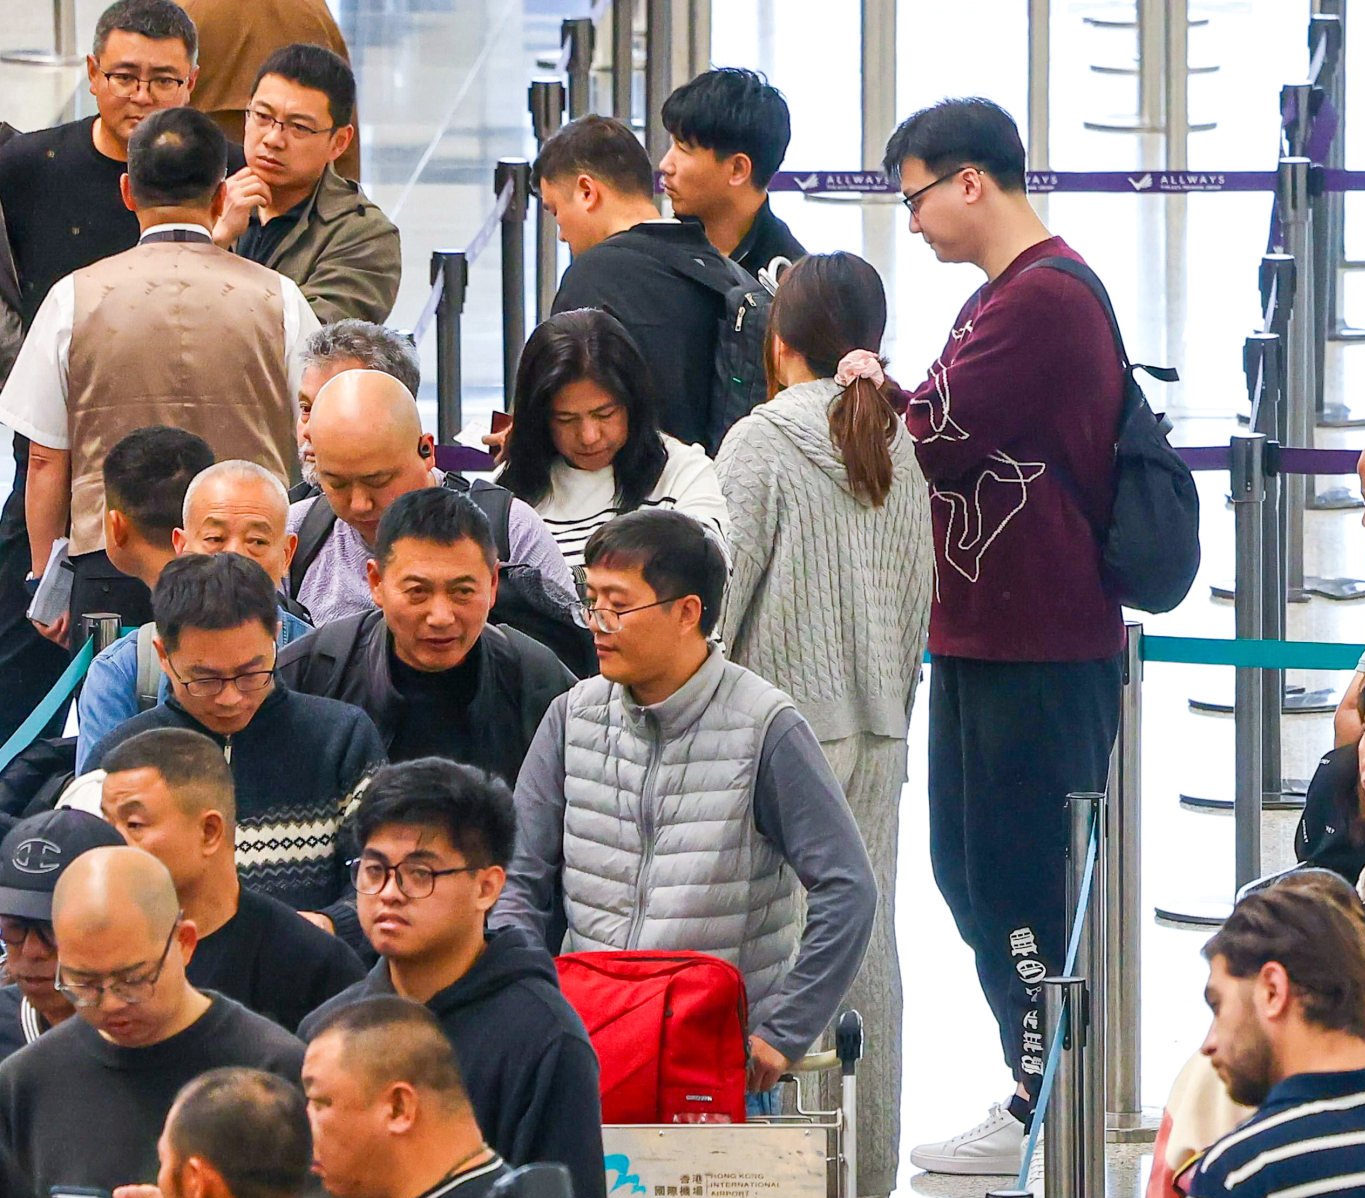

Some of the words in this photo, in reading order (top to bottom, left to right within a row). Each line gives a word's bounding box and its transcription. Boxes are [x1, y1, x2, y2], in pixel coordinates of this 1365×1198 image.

[1160, 176, 1226, 185] ALLWAYS
[680, 1174, 703, 1185] 香港
[654, 1185, 703, 1197] 國際機場
[711, 1190, 749, 1198] AIRPORT
